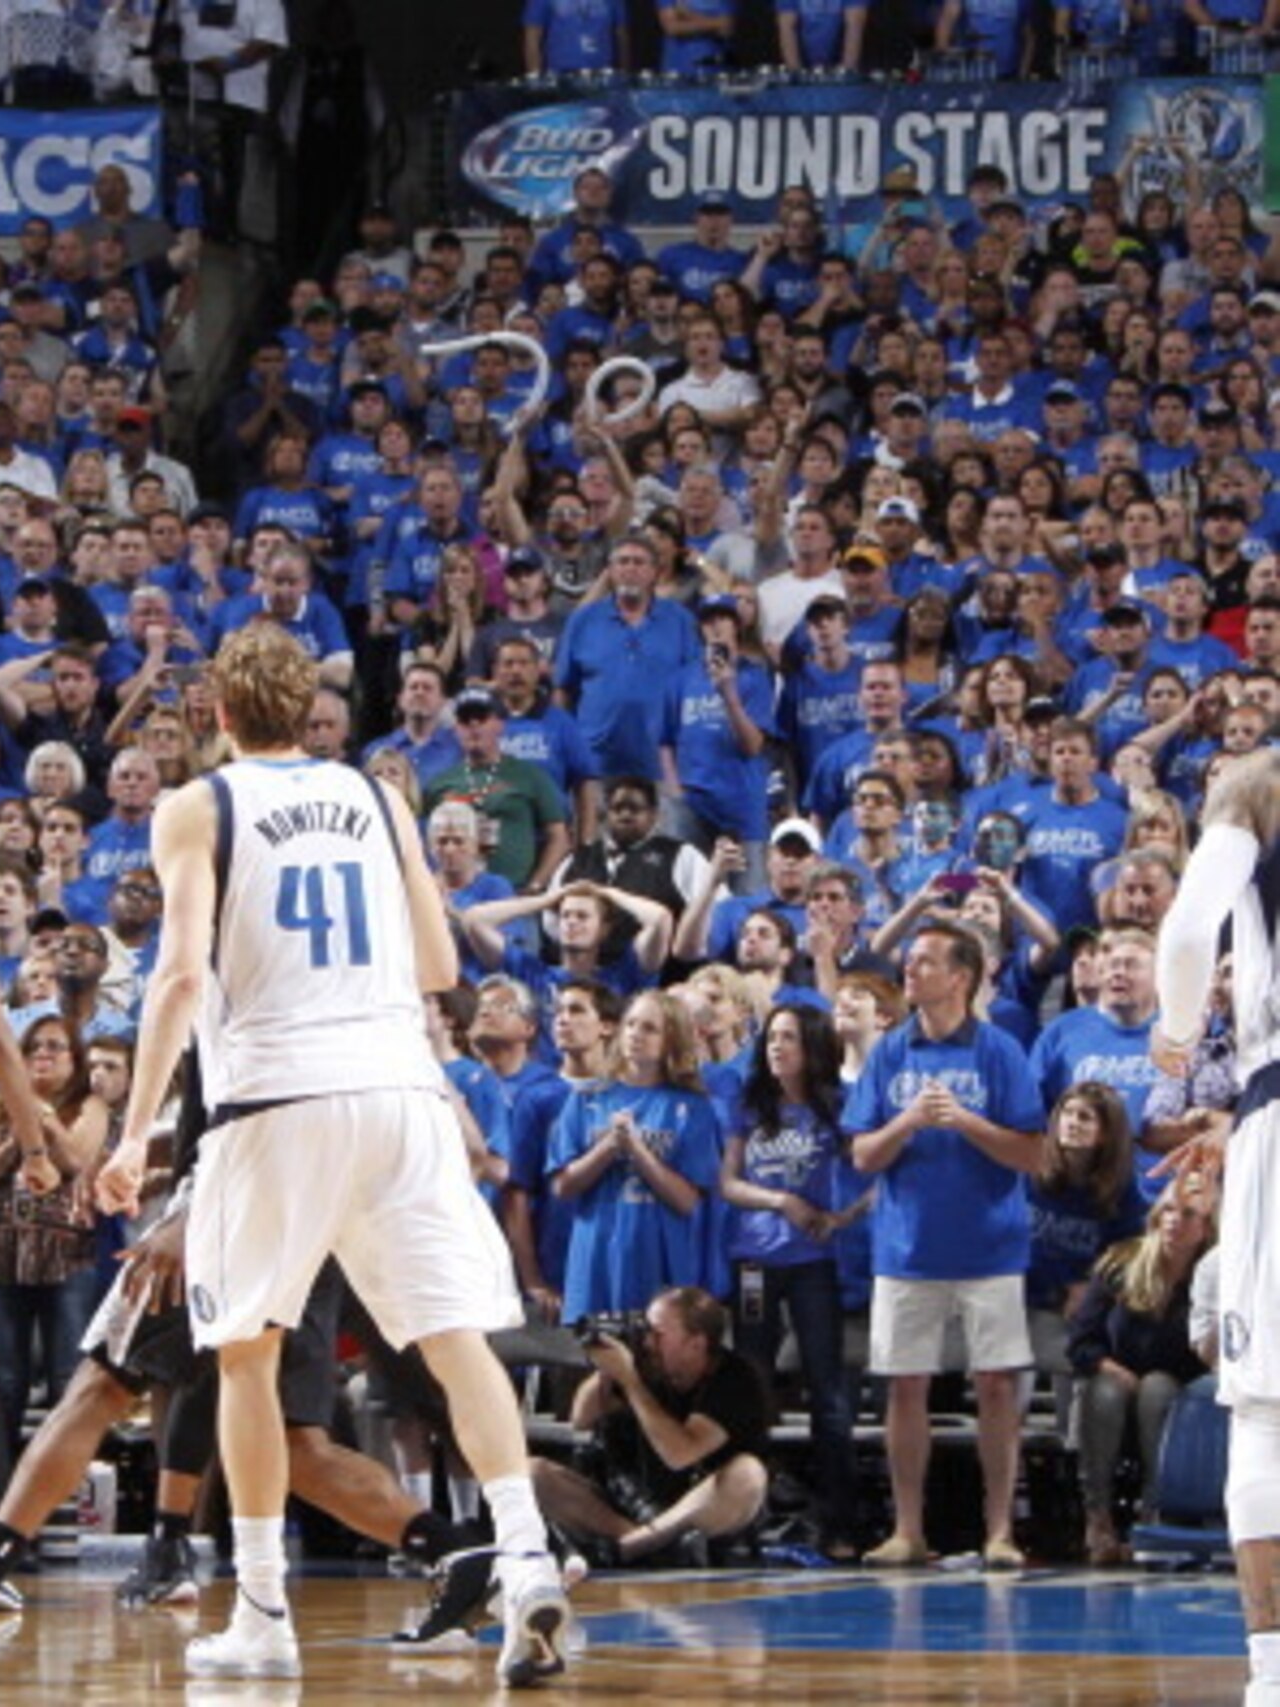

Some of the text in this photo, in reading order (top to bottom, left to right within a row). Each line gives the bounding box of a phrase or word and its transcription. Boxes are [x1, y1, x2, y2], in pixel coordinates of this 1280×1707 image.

[512, 126, 612, 152] BUD
[647, 115, 881, 199] SOUND
[893, 109, 1107, 196] STAGE
[254, 801, 373, 848] NOWITZKI
[275, 861, 372, 970] 41
